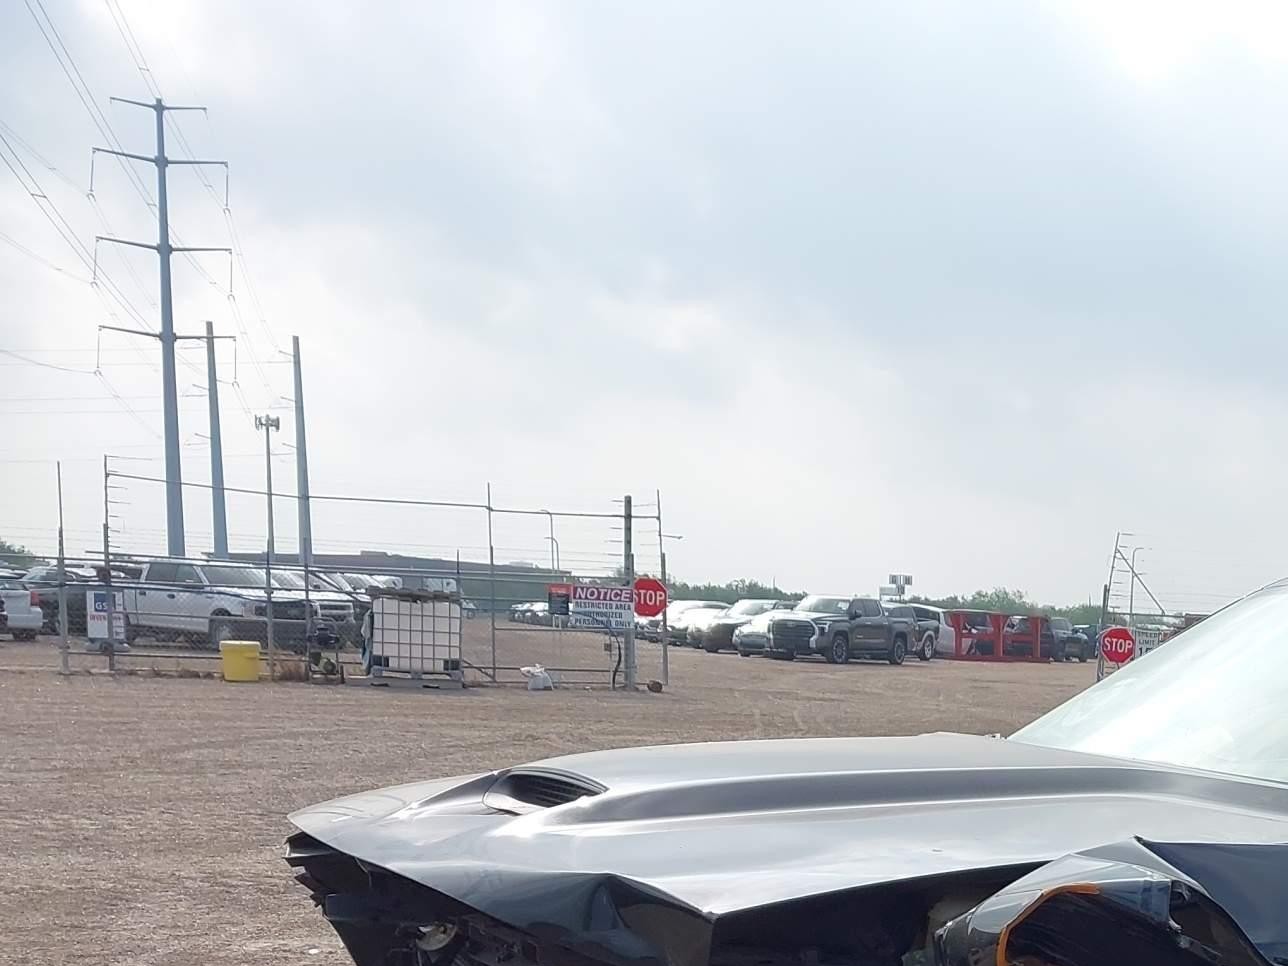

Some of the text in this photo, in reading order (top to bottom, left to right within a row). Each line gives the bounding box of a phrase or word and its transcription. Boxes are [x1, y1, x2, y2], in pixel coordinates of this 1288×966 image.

[576, 587, 631, 601] NOTICE
[575, 601, 631, 611] RESTRICTED AREA
[574, 618, 631, 628] PERSONNEL ONLY
[1104, 637, 1133, 653] STOP
